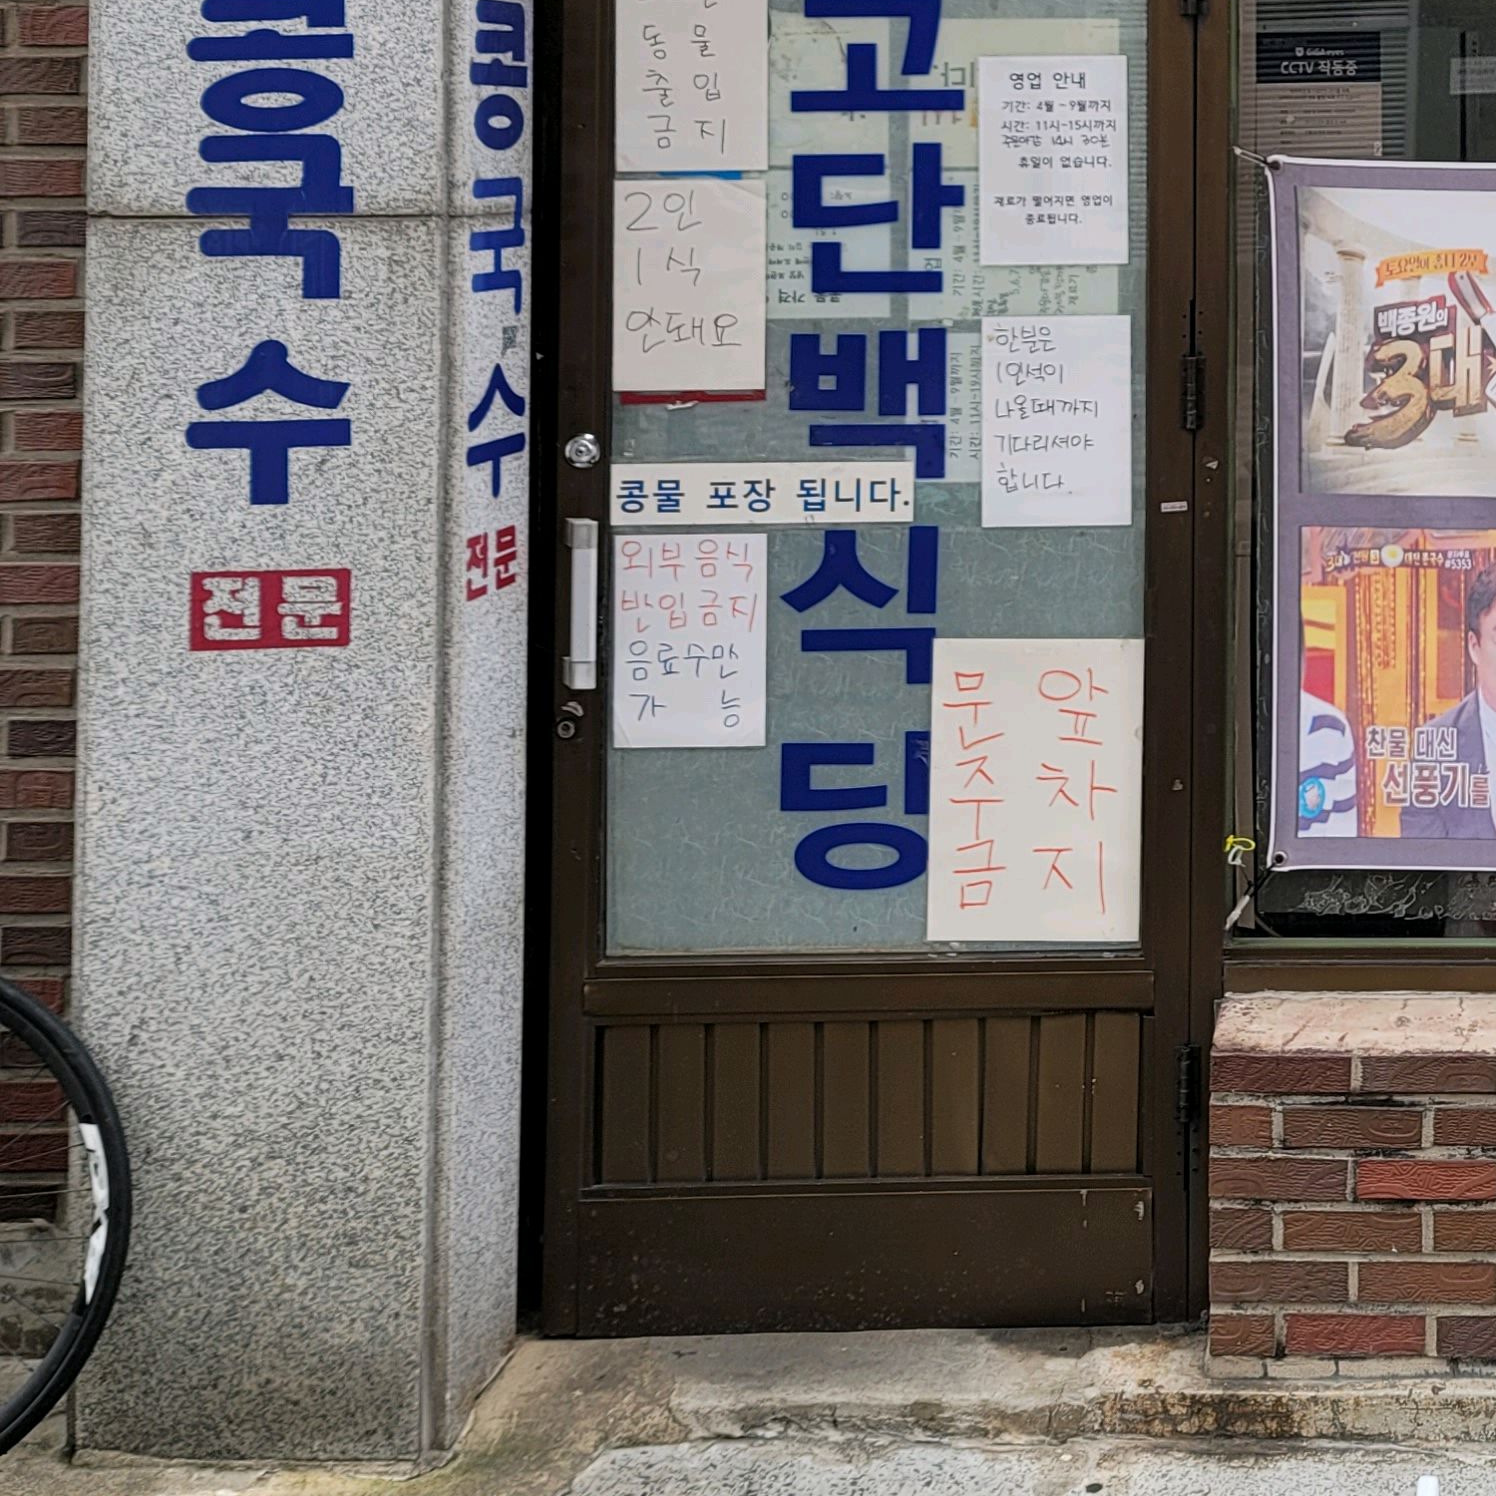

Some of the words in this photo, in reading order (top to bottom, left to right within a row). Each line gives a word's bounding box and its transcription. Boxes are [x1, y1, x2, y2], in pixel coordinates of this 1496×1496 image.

[1009, 71, 1043, 91] 영업
[1052, 71, 1087, 90] 안내
[1280, 60, 1315, 75] CCTV
[1318, 59, 1359, 77] 작동중
[647, 114, 727, 155] 금지
[1001, 120, 1030, 133] 시간:
[1376, 299, 1449, 338] 백종원의
[1345, 316, 1486, 448] 3대
[993, 433, 1096, 456] 기다리셔야
[616, 478, 686, 514] 콩물
[706, 478, 776, 514] 포장
[796, 477, 911, 513] 됩니다.
[465, 523, 517, 602] 전문
[197, 573, 347, 644] 전문
[1366, 726, 1409, 760] 찬물
[1414, 726, 1459, 762] 대신
[1382, 761, 1491, 809] 선풍기를
